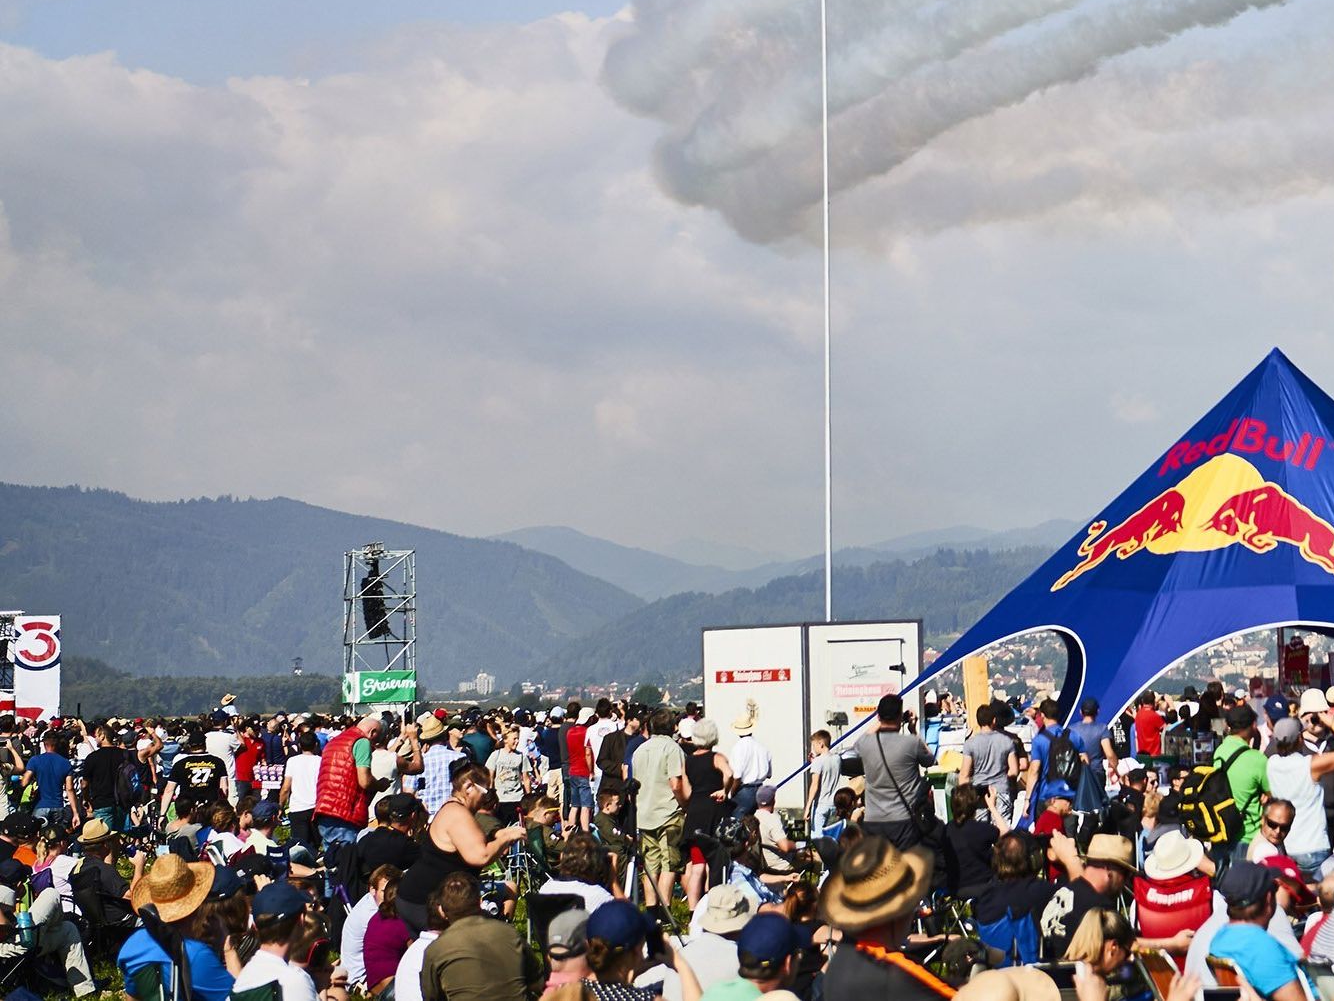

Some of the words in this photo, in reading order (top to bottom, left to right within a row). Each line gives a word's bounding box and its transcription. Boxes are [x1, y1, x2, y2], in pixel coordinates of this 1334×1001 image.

[1157, 418, 1240, 478] Red
[1231, 416, 1327, 472] Bull
[20, 621, 57, 663] 3
[191, 768, 212, 784] 27
